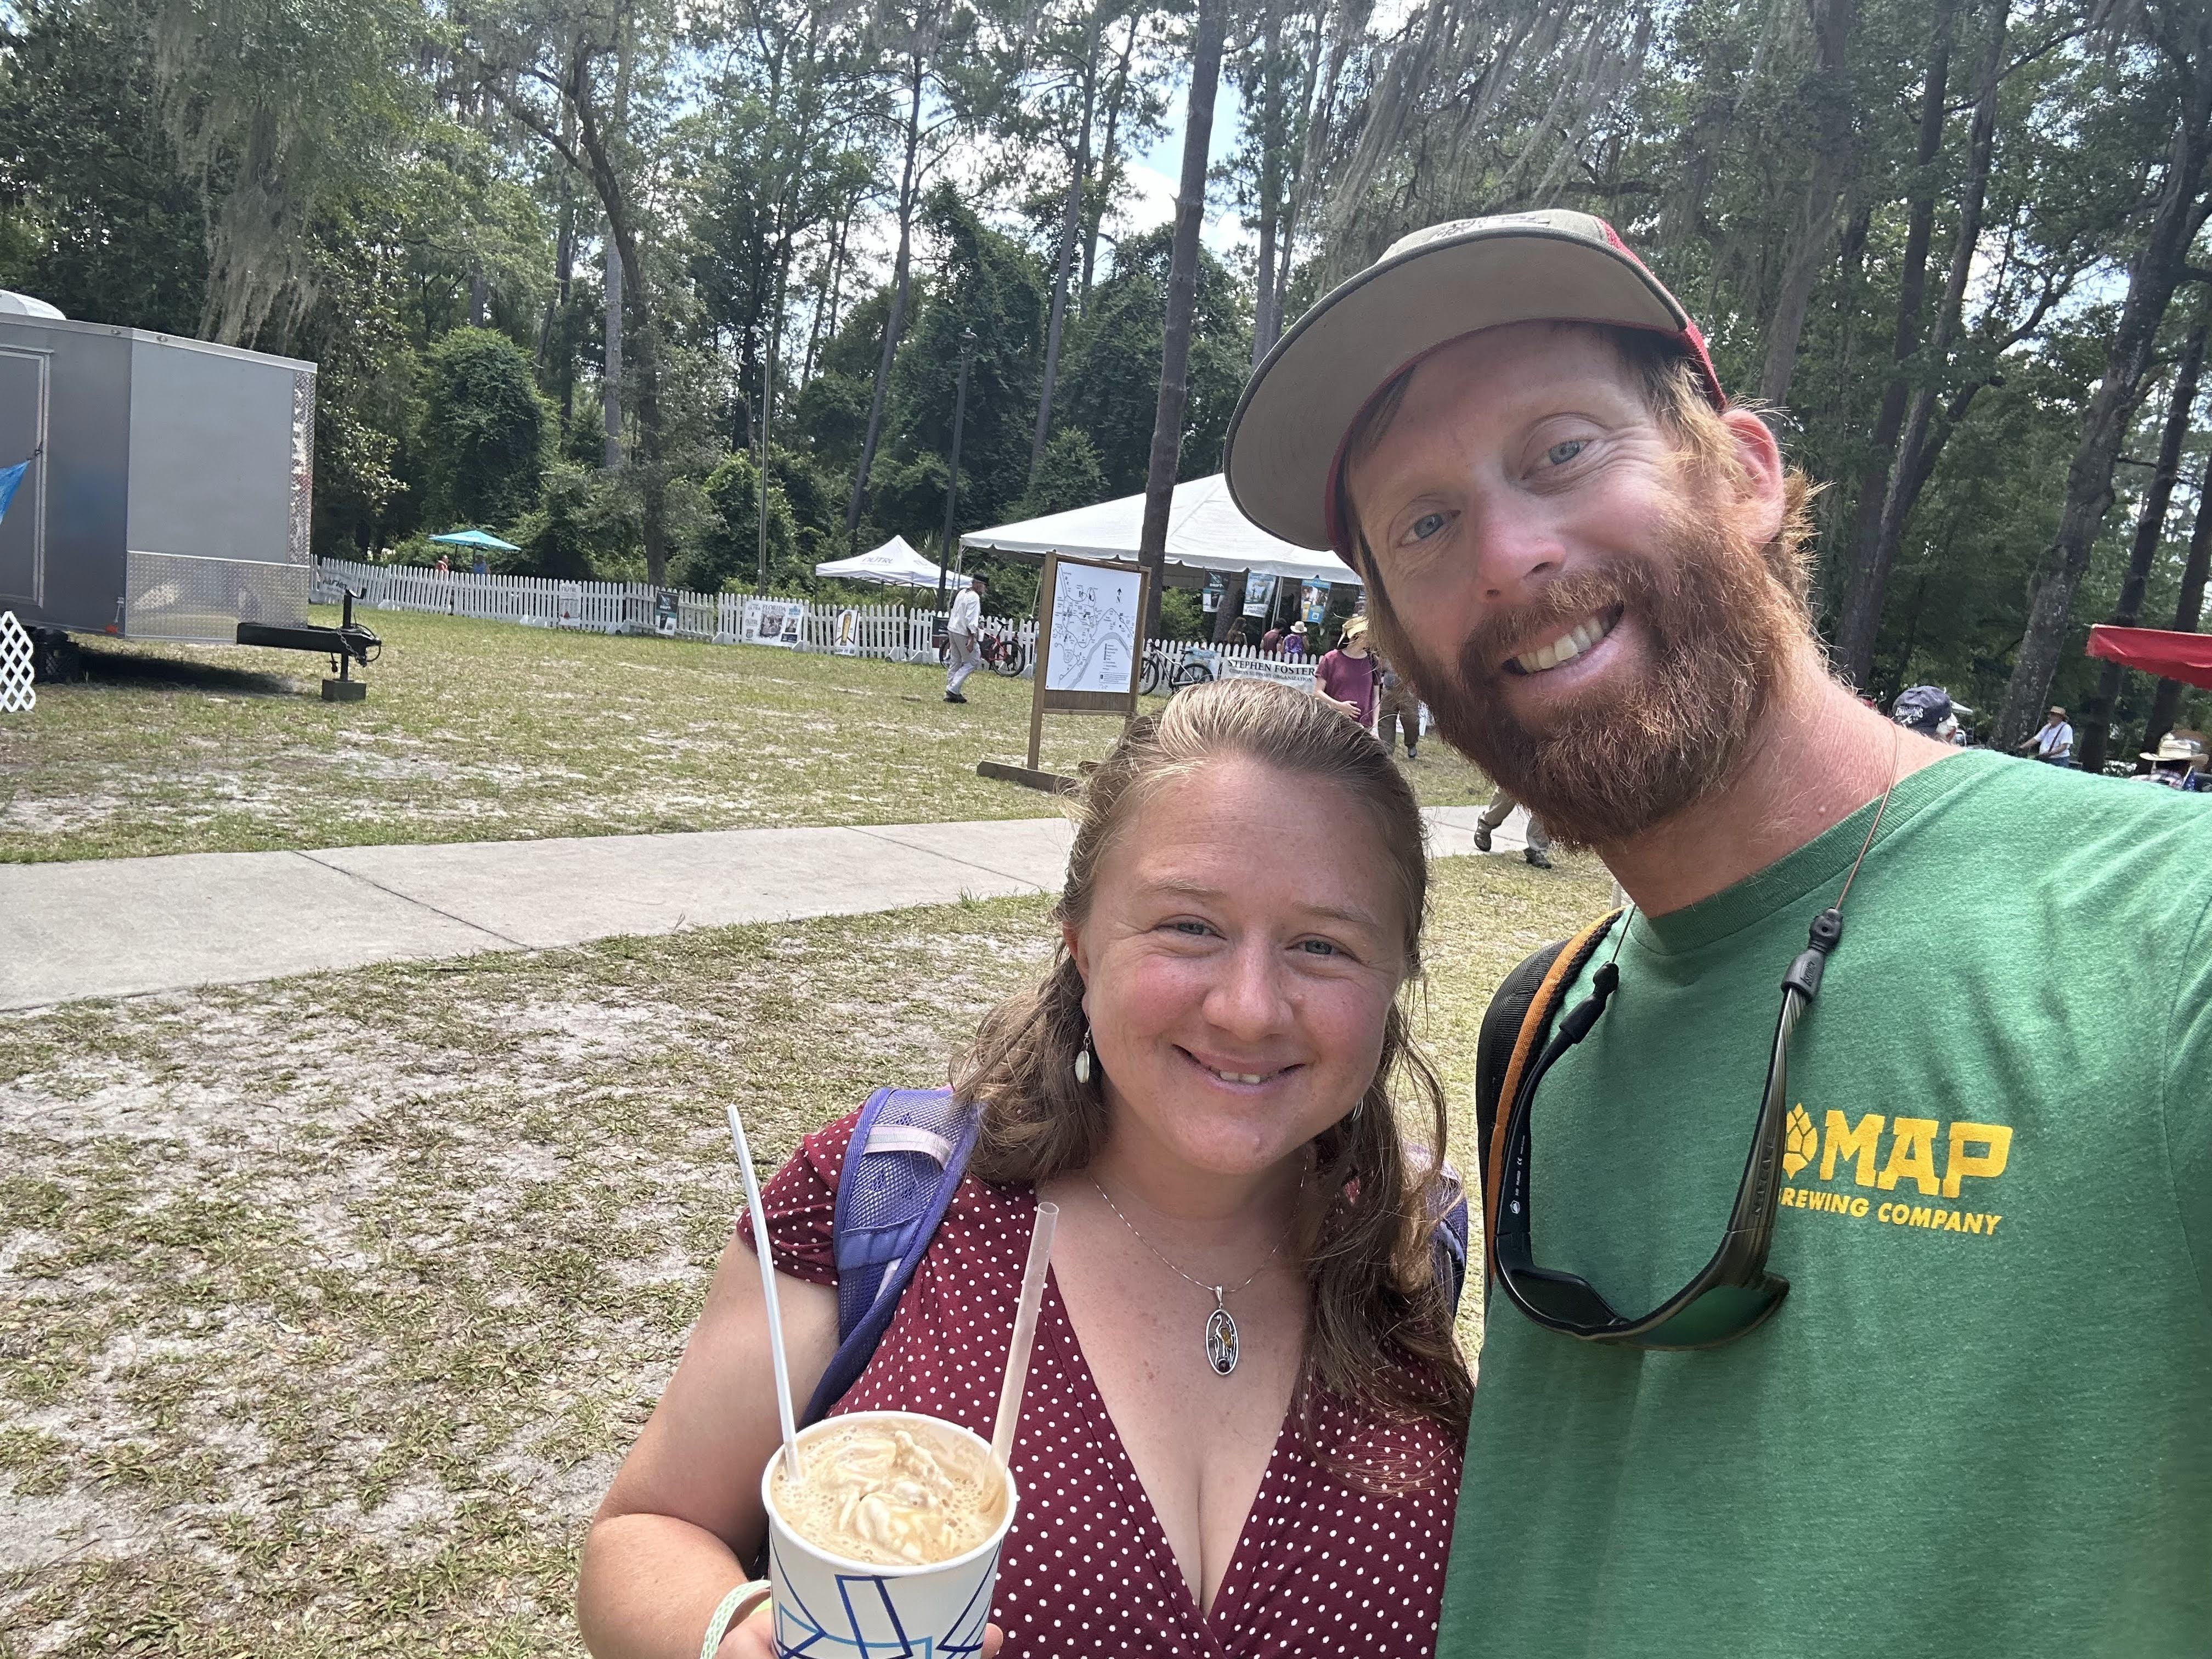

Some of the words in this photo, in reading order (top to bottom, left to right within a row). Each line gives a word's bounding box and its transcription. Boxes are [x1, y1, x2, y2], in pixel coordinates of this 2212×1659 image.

[1228, 660, 1272, 672] STEPHEN
[1275, 665, 1316, 676] FOSTER
[1819, 1109, 2013, 1199] MAP
[1779, 1187, 1870, 1217] REWING
[1878, 1202, 2002, 1235] COMPANY
